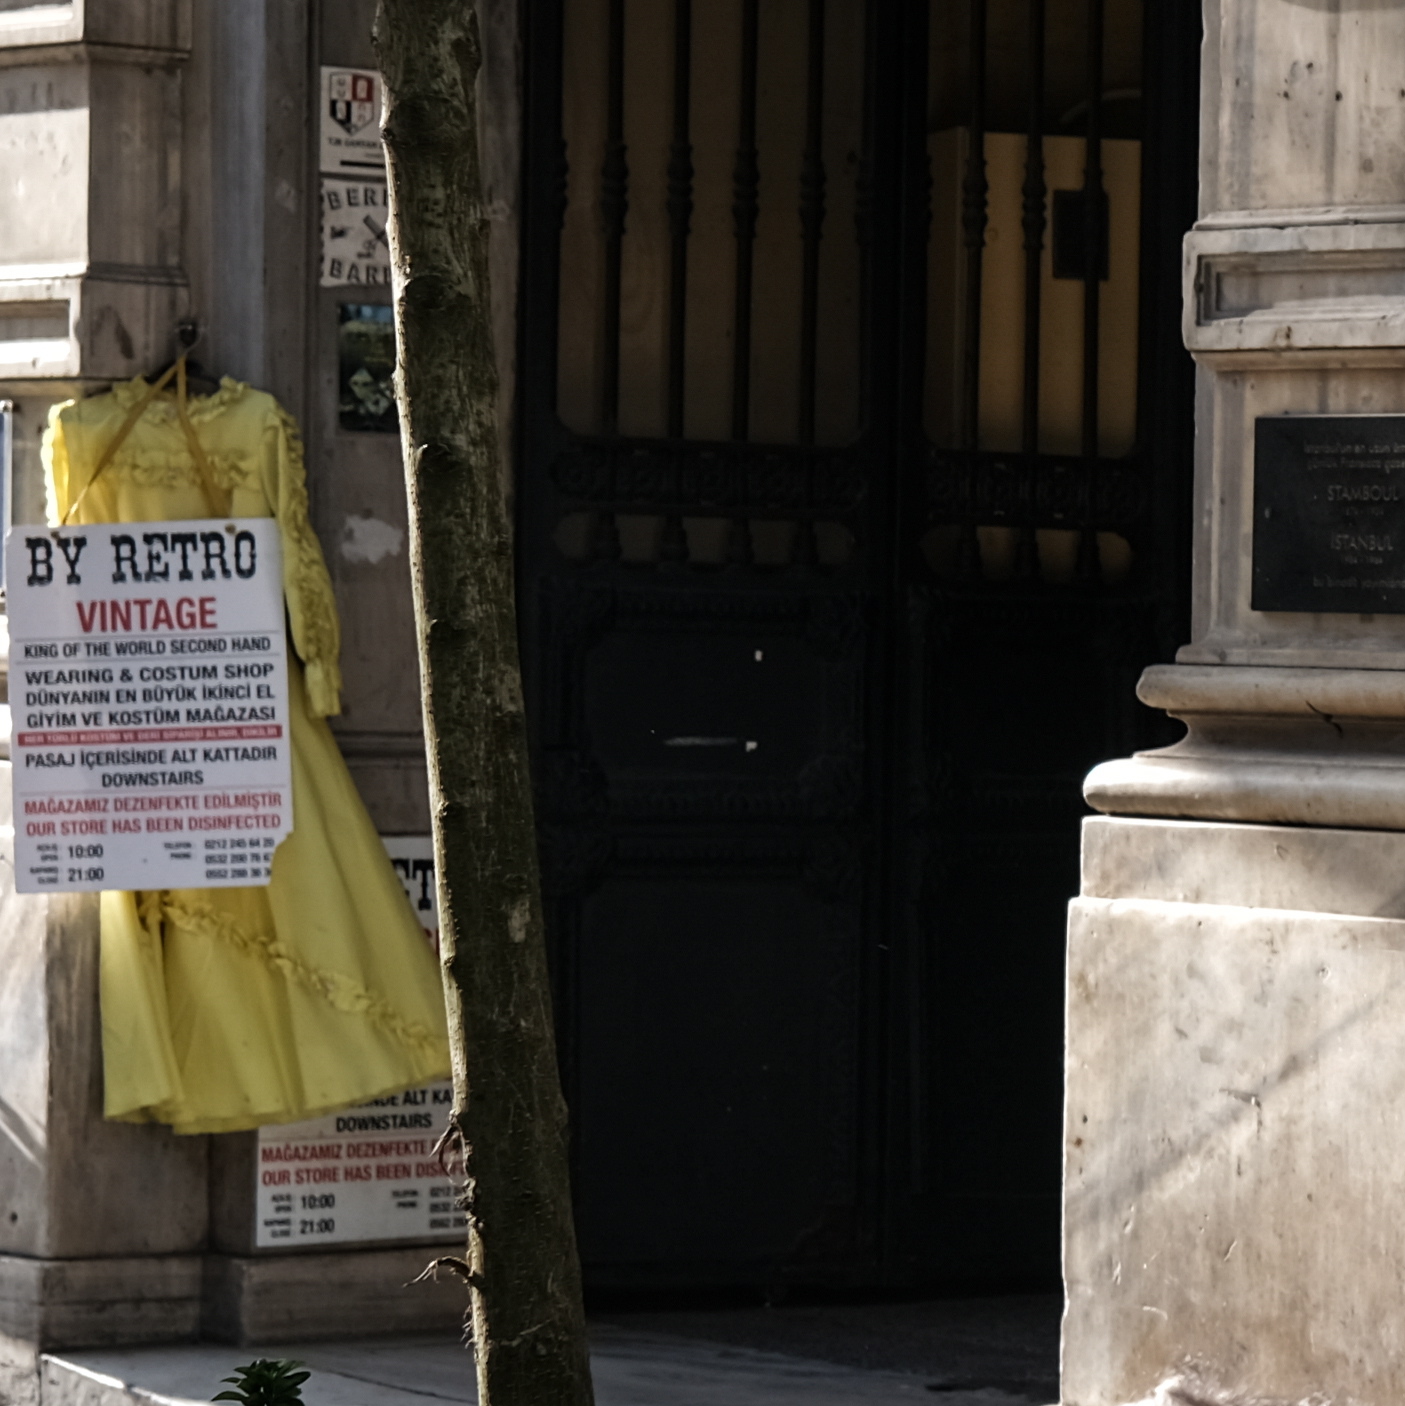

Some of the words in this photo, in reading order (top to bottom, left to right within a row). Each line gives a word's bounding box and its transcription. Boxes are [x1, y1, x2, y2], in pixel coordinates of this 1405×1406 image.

[25, 536, 87, 587] BY
[110, 530, 257, 583] RETRO
[76, 596, 218, 633] VINTAGE
[24, 642, 59, 659] KING
[63, 641, 80, 658] OF
[84, 640, 112, 656] THE
[115, 639, 166, 656] WORLD
[170, 637, 227, 654] SECOND
[231, 636, 271, 652] HAND
[25, 667, 113, 686] WEARING
[119, 668, 133, 682] &
[139, 665, 218, 682] COSTUM
[224, 662, 274, 679] SHOP
[25, 687, 110, 707] DÜNYANIN
[116, 688, 136, 703] EN
[142, 684, 197, 702] BÜYÜK
[202, 684, 251, 700] İKİNCİ
[256, 684, 275, 699] EL
[27, 709, 77, 729] GİYİM
[81, 711, 103, 727] VE
[109, 707, 180, 725] KOSTÜM
[186, 706, 275, 723] MAĞAZASI
[25, 753, 75, 768] PASAJ
[171, 748, 196, 763] ALT
[203, 746, 277, 762] KATTADIR
[101, 770, 204, 788] DOWNSTAIRS
[24, 796, 110, 815] MAĞAZAMIZ
[113, 794, 199, 813] DEZENFEKTE
[204, 790, 281, 810] EDİLMİŞTİR
[26, 821, 56, 838] OUR
[61, 819, 107, 836] STORE
[112, 817, 141, 834] HAS
[146, 816, 183, 832] BEEN
[188, 813, 281, 831] DISINFECTED
[68, 844, 103, 860] 10:00
[68, 867, 104, 883] 21:00
[336, 1113, 432, 1133] DOWNSTAIRS
[261, 1142, 341, 1163] MAĞAZAMIZ
[347, 1139, 426, 1159] DEZENFEKTE
[262, 1170, 290, 1187] OUR
[295, 1167, 341, 1184] STORE
[343, 1165, 372, 1182] HAS
[376, 1163, 412, 1179] BEEN
[301, 1194, 335, 1210] 10:00
[300, 1218, 335, 1235] 21:00
